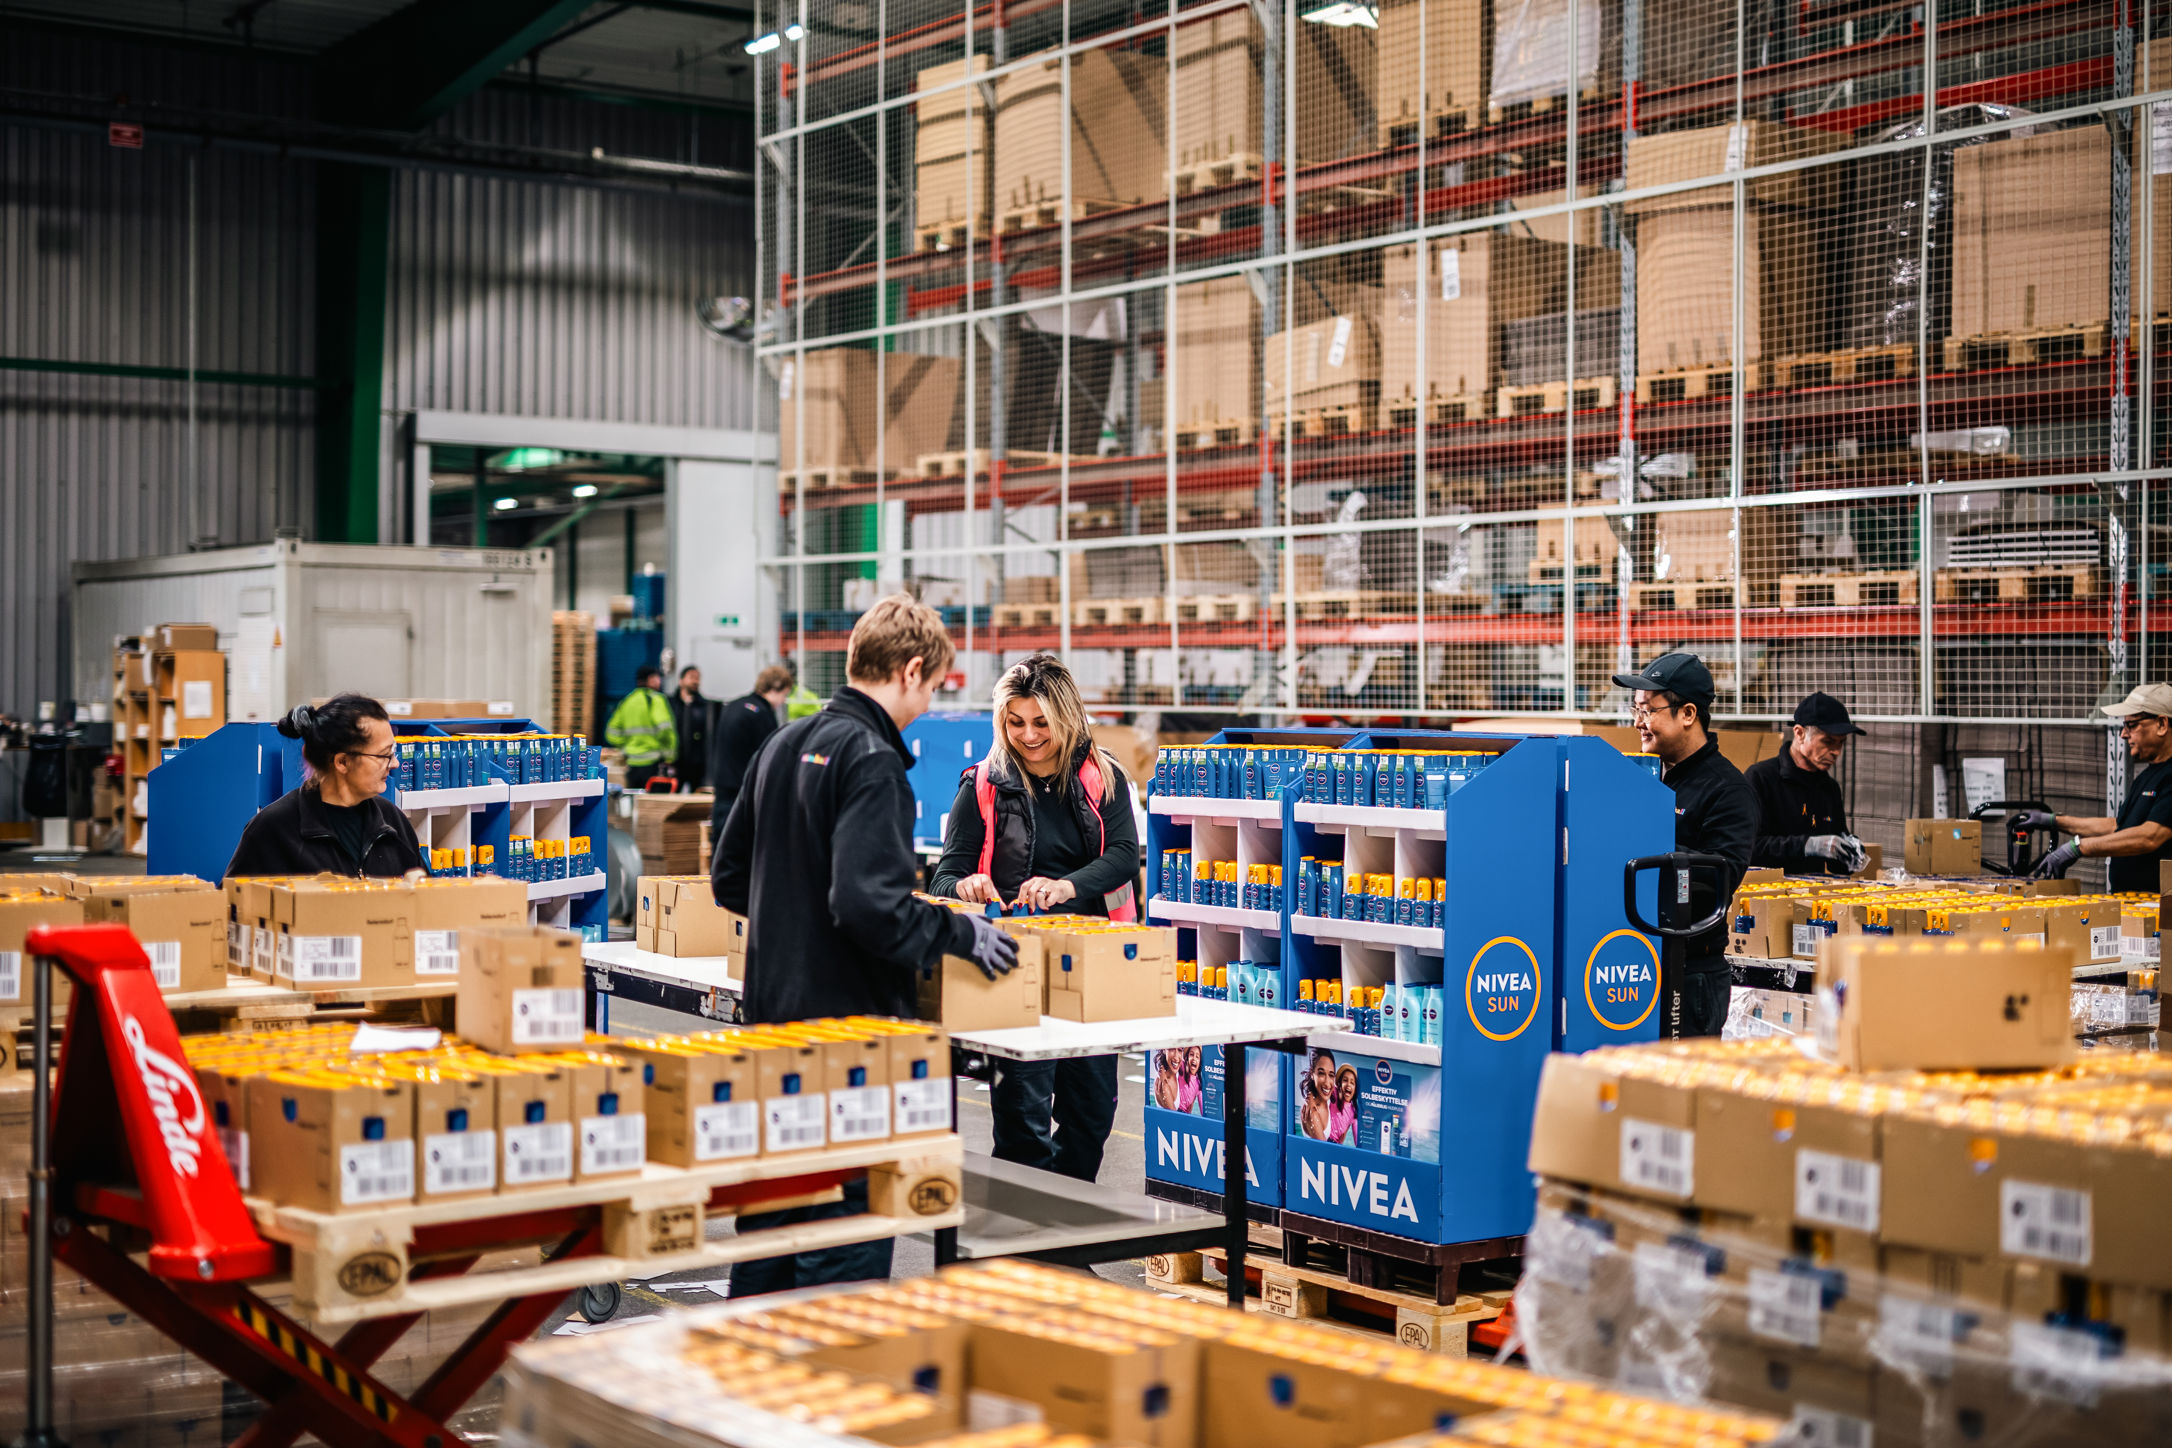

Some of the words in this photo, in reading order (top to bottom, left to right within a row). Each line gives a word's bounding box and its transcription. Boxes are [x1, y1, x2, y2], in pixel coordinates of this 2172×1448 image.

[1477, 972, 1532, 993] NIVEA
[1595, 964, 1652, 984] NIVEA
[1487, 996, 1519, 1013] SUN
[1607, 986, 1639, 1003] SUN
[124, 1014, 205, 1179] Linde
[1360, 1092, 1409, 1107] SOLBESKYTTELSE
[1371, 1085, 1398, 1096] EFFEKTIV
[917, 1187, 952, 1210] EPAL
[1301, 1156, 1419, 1223] NIVEA
[1150, 1256, 1166, 1274] EPAL
[349, 1263, 393, 1289] EPAL
[1405, 1326, 1424, 1347] EPAL
